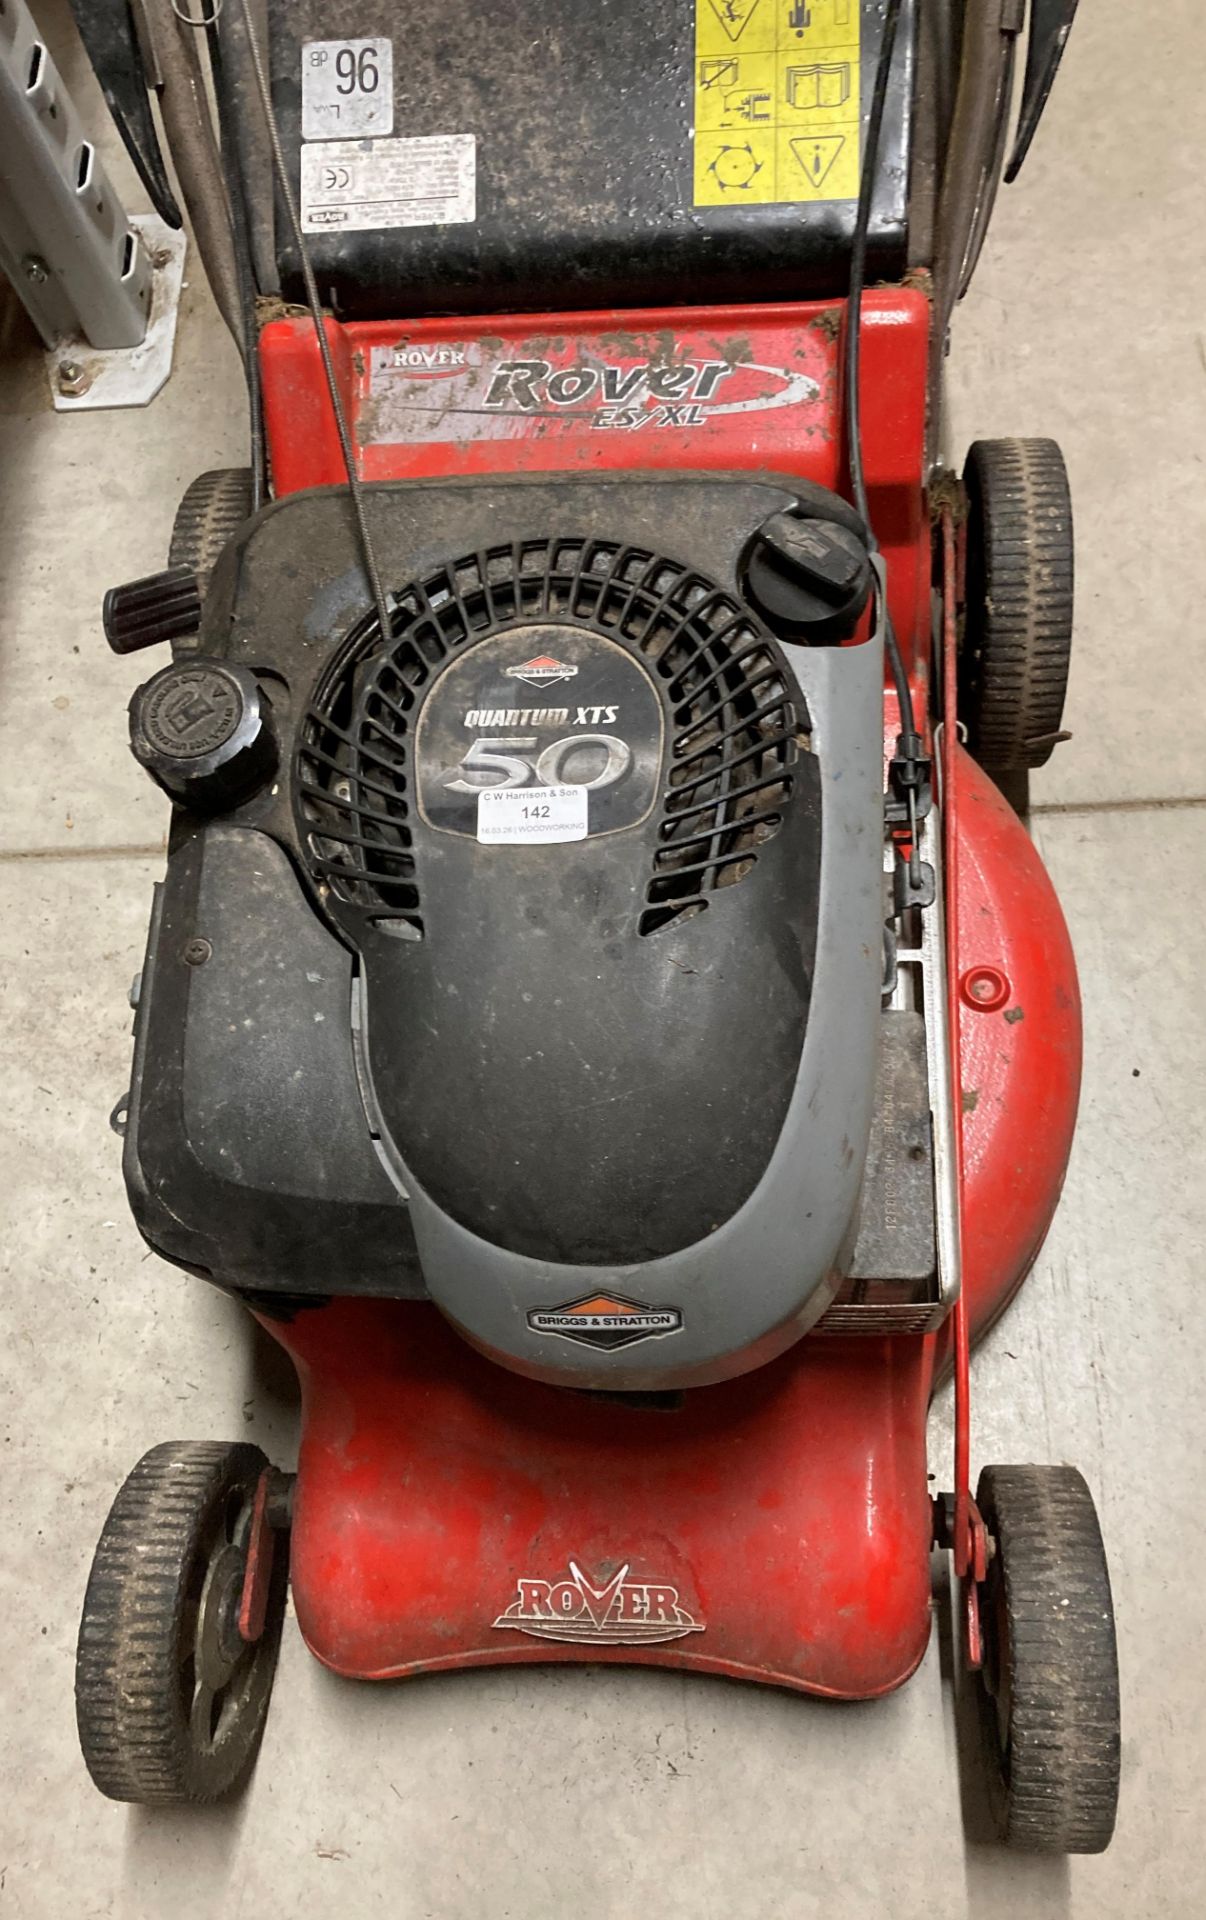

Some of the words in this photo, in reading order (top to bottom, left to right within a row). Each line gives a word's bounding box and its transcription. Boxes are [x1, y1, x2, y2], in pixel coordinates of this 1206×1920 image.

[310, 50, 328, 67] dB
[335, 47, 379, 95] 96
[310, 211, 347, 223] ROVER
[393, 350, 465, 368] ROVER
[484, 360, 733, 411] Rover
[590, 404, 707, 432] ES/XL
[464, 707, 570, 729] QUANTUM
[573, 705, 620, 725] XTS
[443, 734, 632, 793] 50
[483, 793, 491, 801] C
[493, 792, 503, 801] W
[506, 790, 547, 800] Harrison
[550, 789, 557, 797] &
[560, 788, 578, 797] Son
[521, 805, 551, 819] 142
[518, 822, 585, 833] WOODWORKING
[538, 1316, 587, 1326] BRIGGS
[591, 1317, 600, 1326] &
[603, 1315, 671, 1326] STRATTON
[517, 1561, 683, 1631] ROVER
